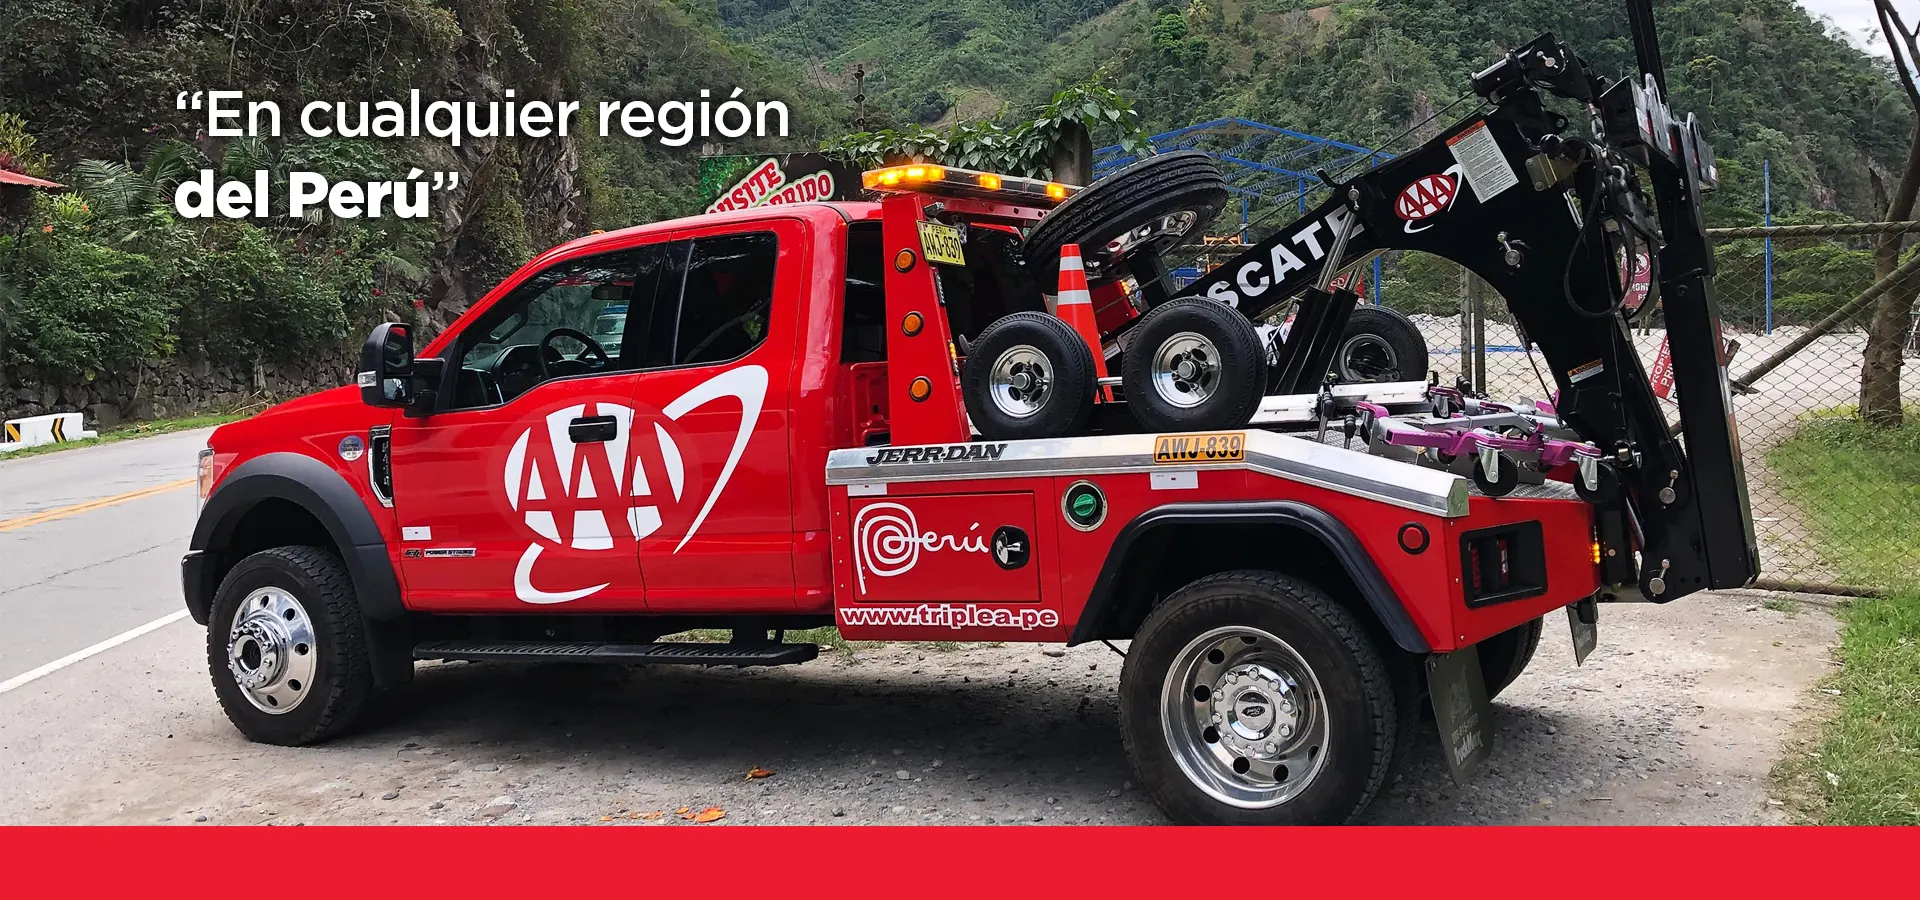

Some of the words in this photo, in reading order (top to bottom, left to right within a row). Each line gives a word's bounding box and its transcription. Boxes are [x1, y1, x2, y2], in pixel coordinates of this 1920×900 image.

[1398, 177, 1452, 218] AAA
[1199, 204, 1365, 309] SCATE
[866, 443, 1008, 465] JERR-DAN
[1157, 435, 1241, 460] AWJ-839
[505, 402, 685, 550] AAA
[853, 502, 989, 595] Perú
[840, 603, 1059, 630] www.triplea.pe
